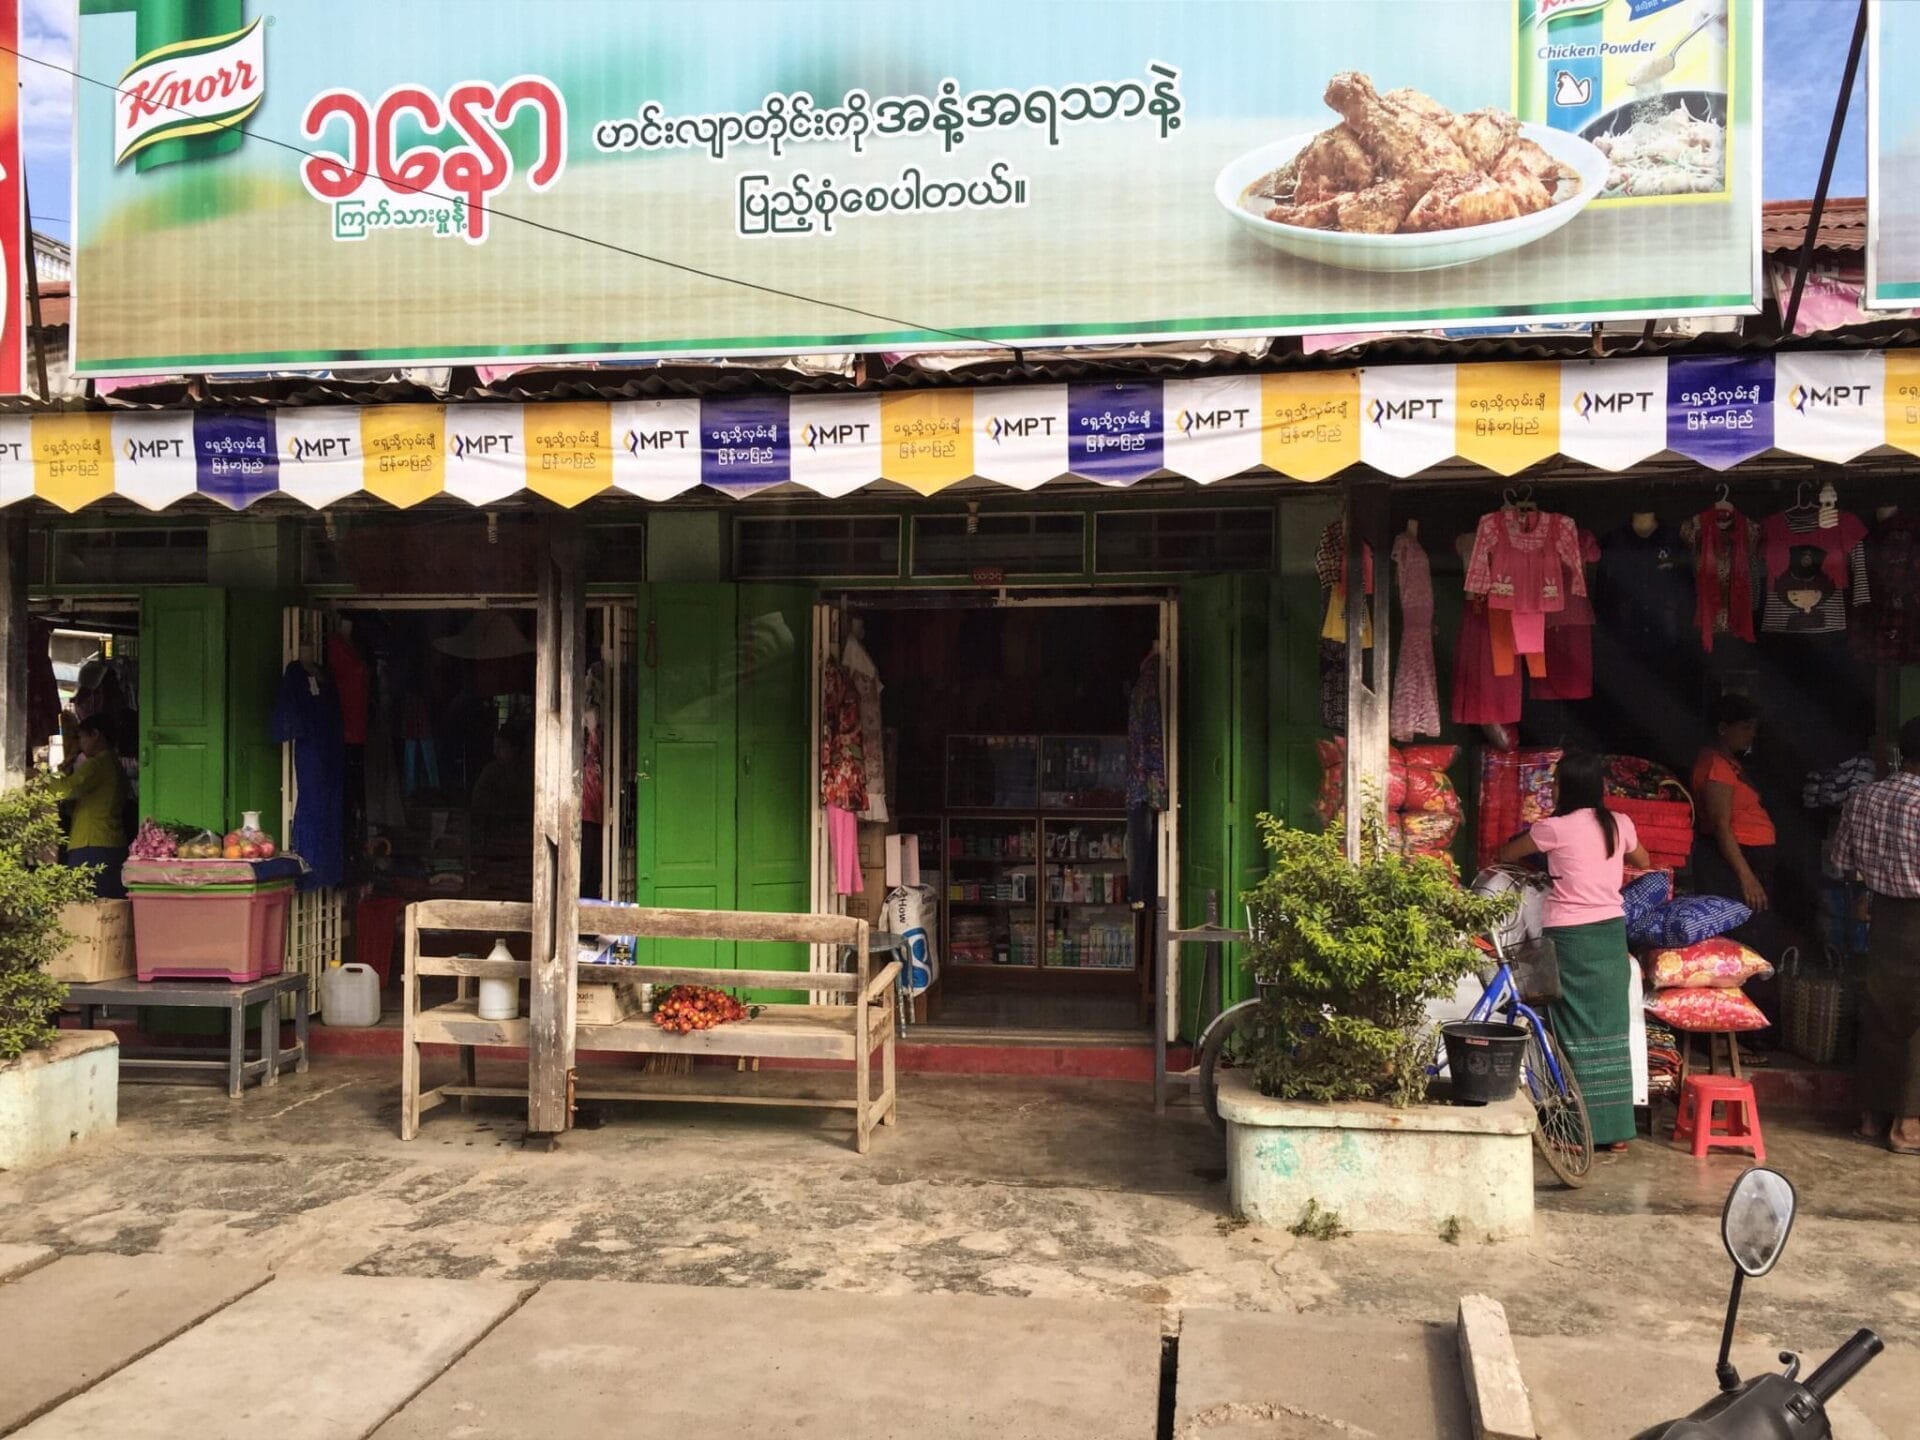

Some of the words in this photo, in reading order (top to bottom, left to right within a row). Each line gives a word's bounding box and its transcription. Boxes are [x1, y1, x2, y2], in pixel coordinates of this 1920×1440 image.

[1537, 44, 1596, 60] Chicken
[1599, 40, 1657, 56] Powder
[119, 60, 257, 129] Knorr
[306, 81, 561, 238] ခနော
[1595, 392, 1653, 412] MPT
[1811, 386, 1870, 406] MPT
[1196, 409, 1249, 429] MPT
[1387, 399, 1443, 420] MPT
[820, 424, 869, 444] MPT
[1004, 417, 1056, 436] MPT
[139, 440, 183, 458] MPT
[304, 438, 350, 456] MPT
[466, 435, 513, 454] MPT
[640, 431, 689, 449] MPT
